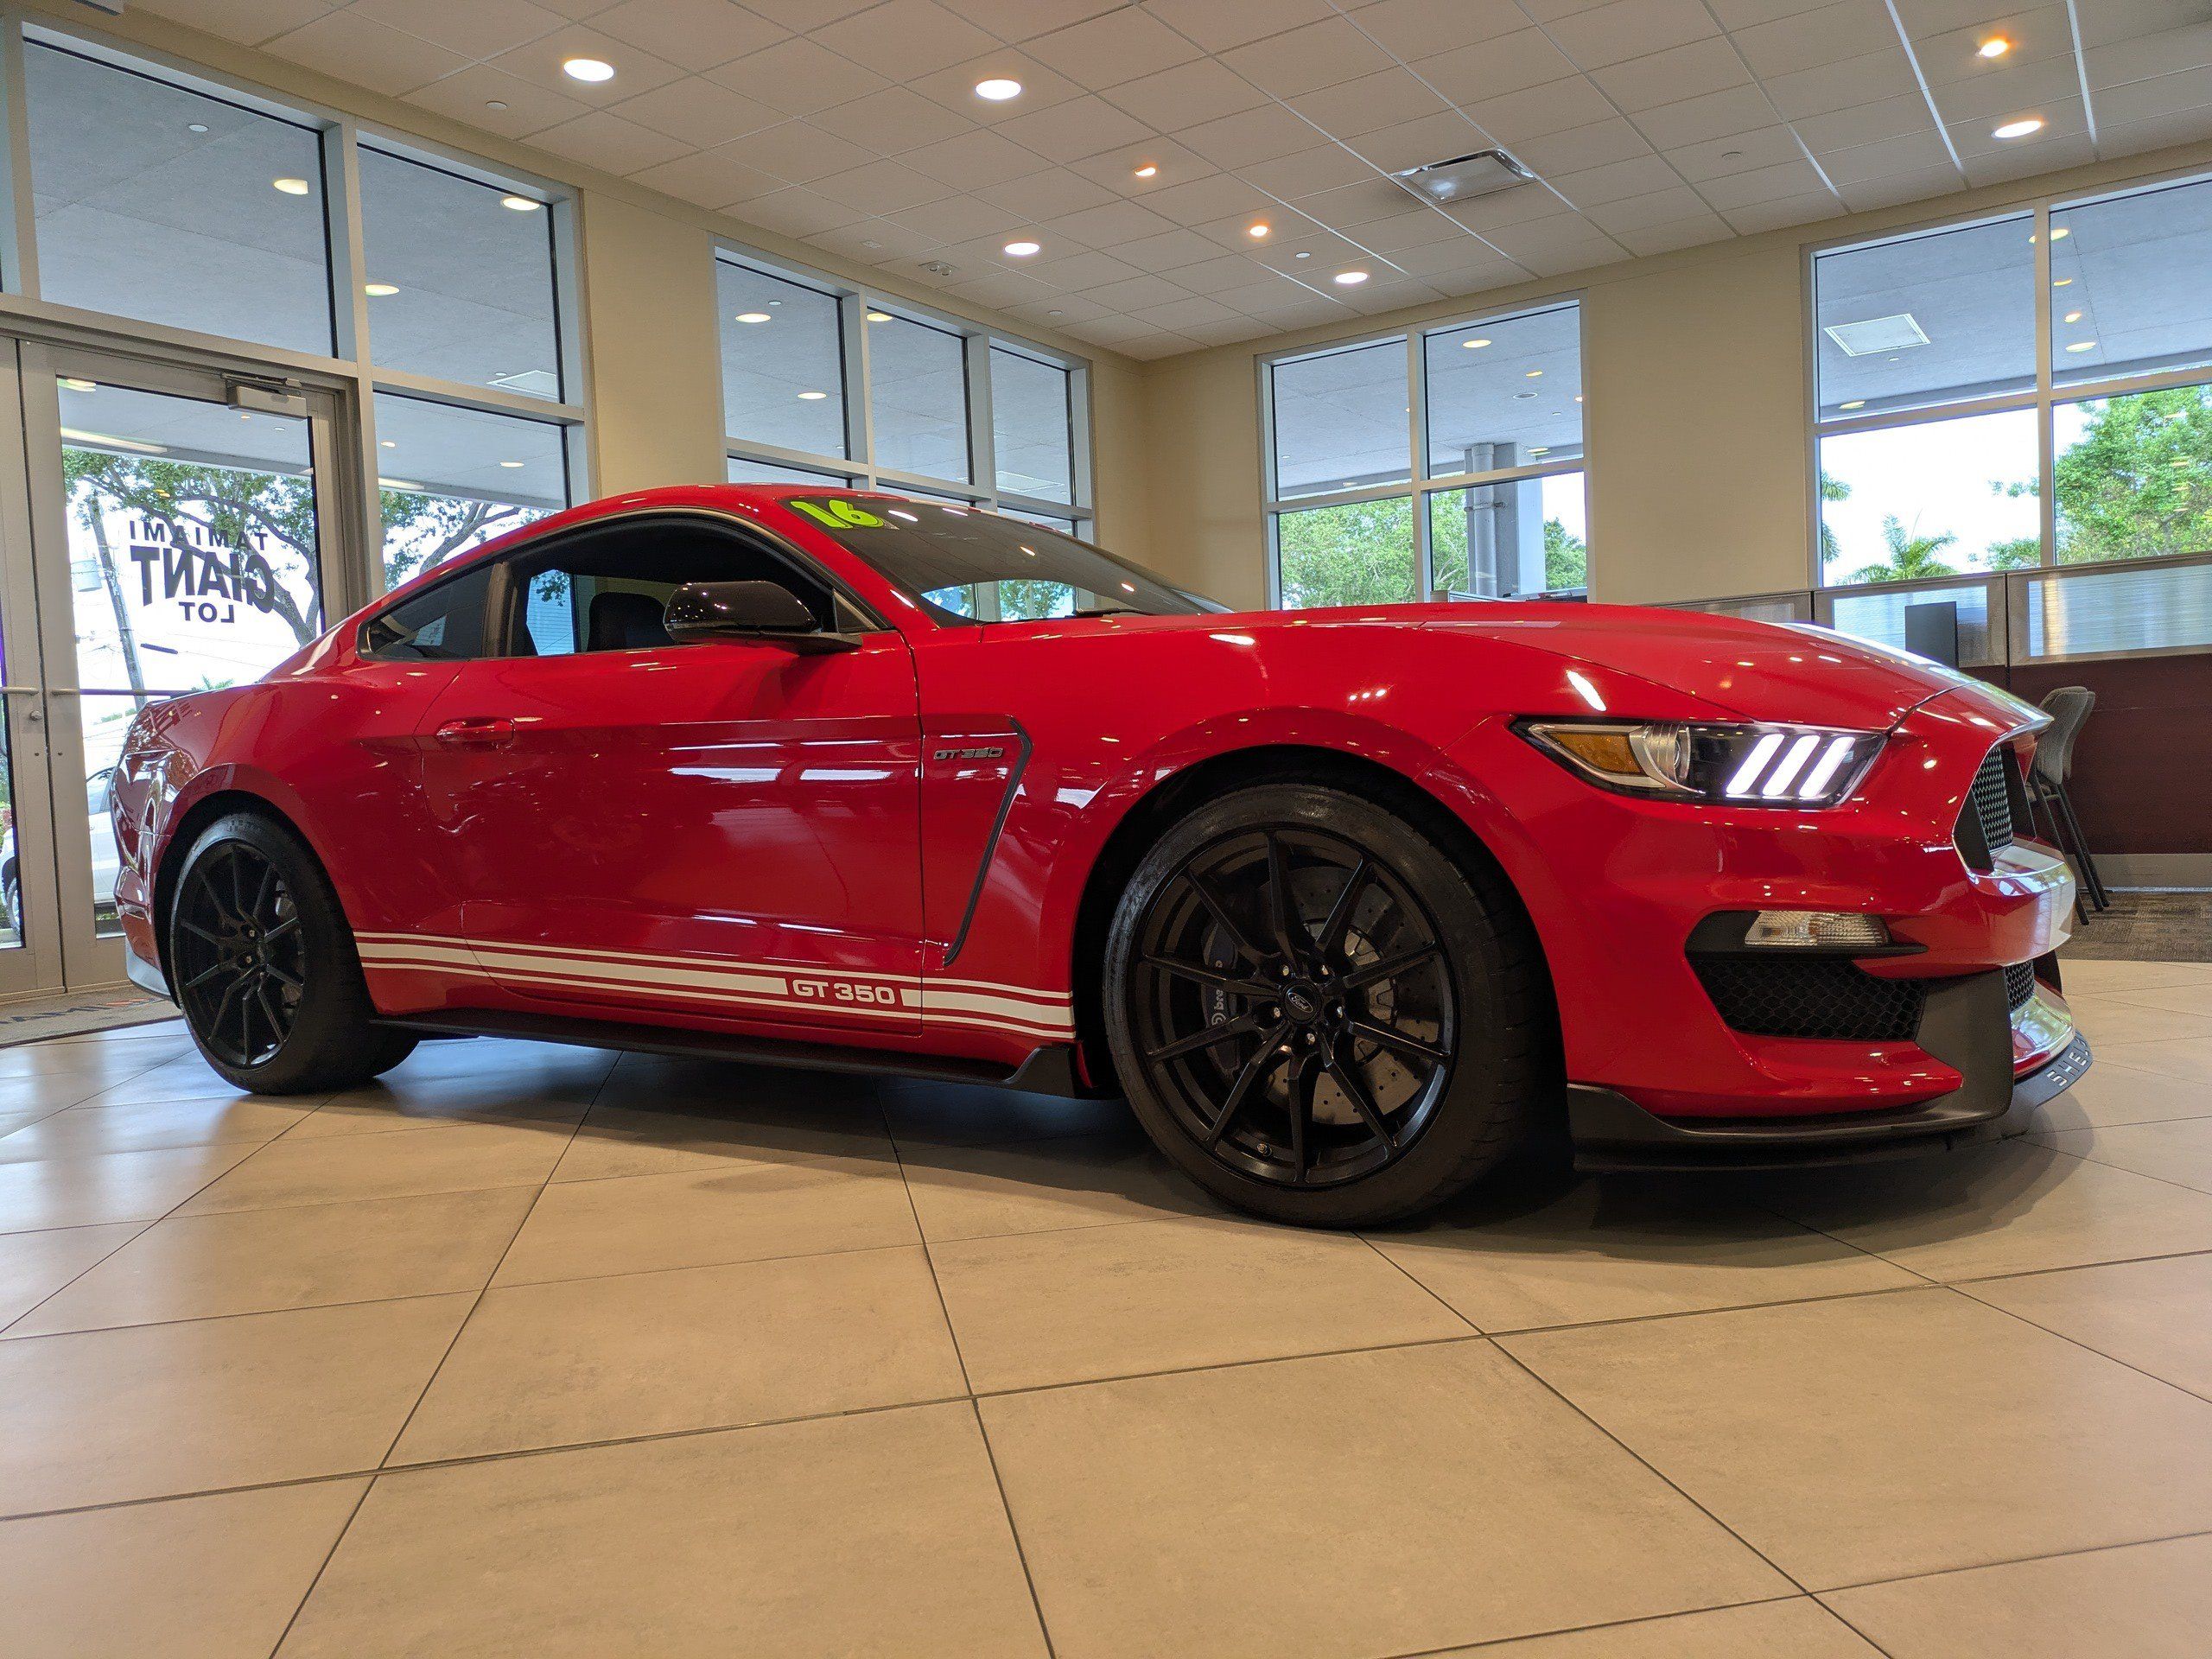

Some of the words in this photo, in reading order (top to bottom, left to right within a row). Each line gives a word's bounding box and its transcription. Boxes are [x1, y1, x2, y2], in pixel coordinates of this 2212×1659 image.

[790, 499, 884, 529] 16
[792, 979, 829, 998] GT
[834, 982, 895, 1005] 350
